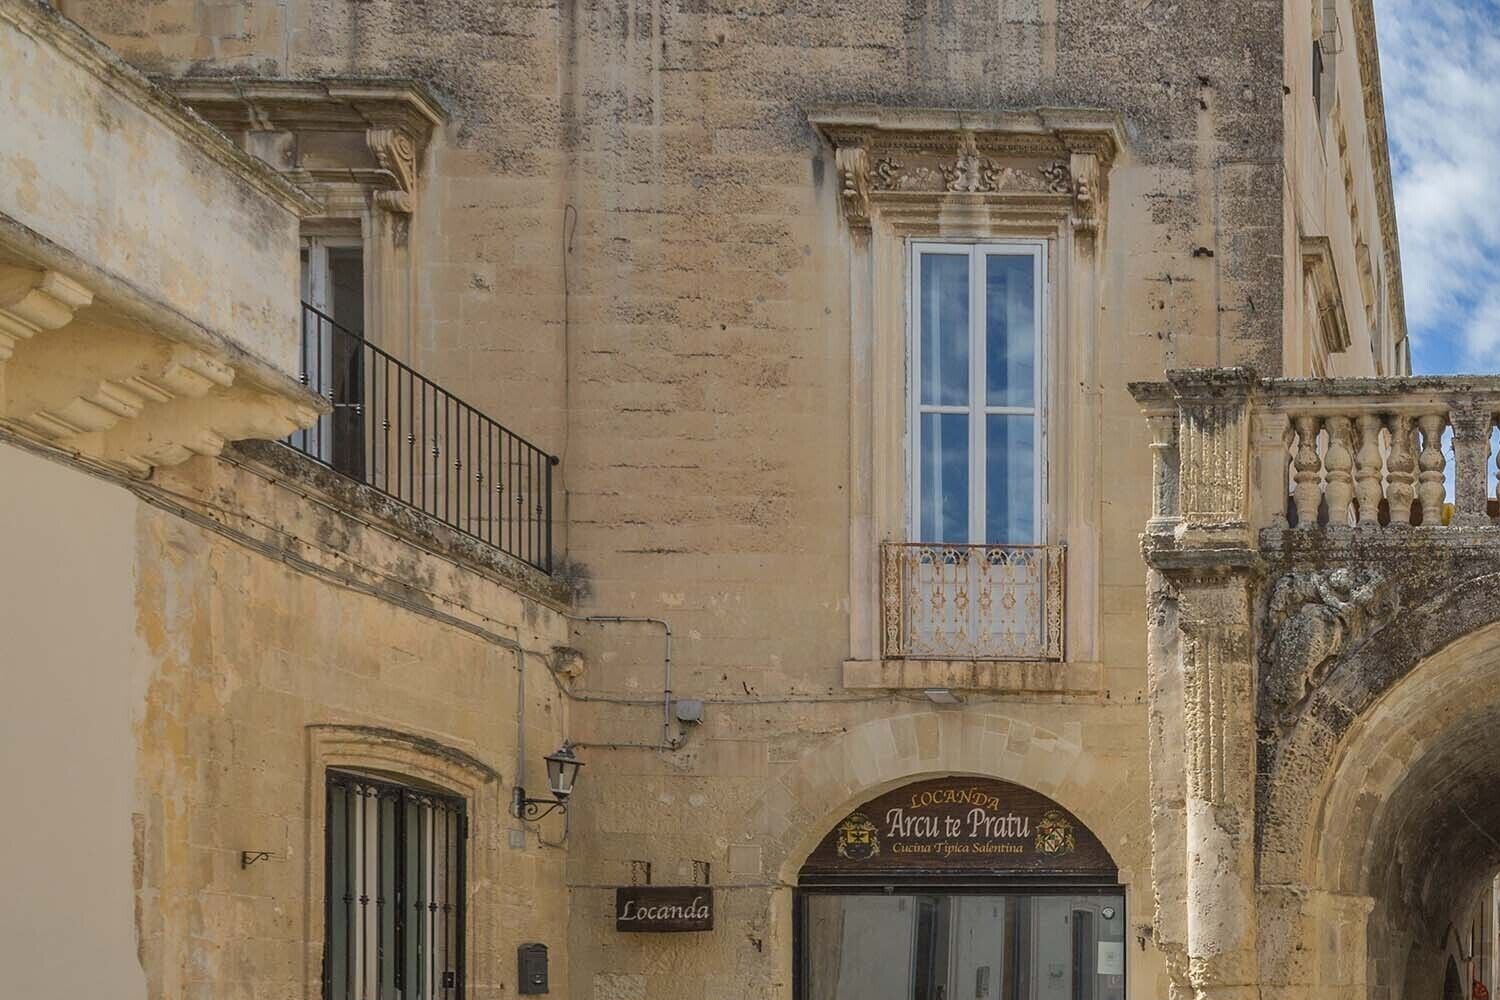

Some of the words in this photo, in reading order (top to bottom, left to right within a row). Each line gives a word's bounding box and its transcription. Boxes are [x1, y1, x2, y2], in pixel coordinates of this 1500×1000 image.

[911, 786, 1000, 811] LOCANDA
[886, 808, 940, 837] Arcu
[945, 815, 961, 837] te
[967, 808, 1031, 838] Pratu
[892, 842, 931, 853] Cucina
[934, 840, 969, 858] Tipica
[972, 840, 1024, 853] Salentina
[618, 896, 710, 920] Locanda
